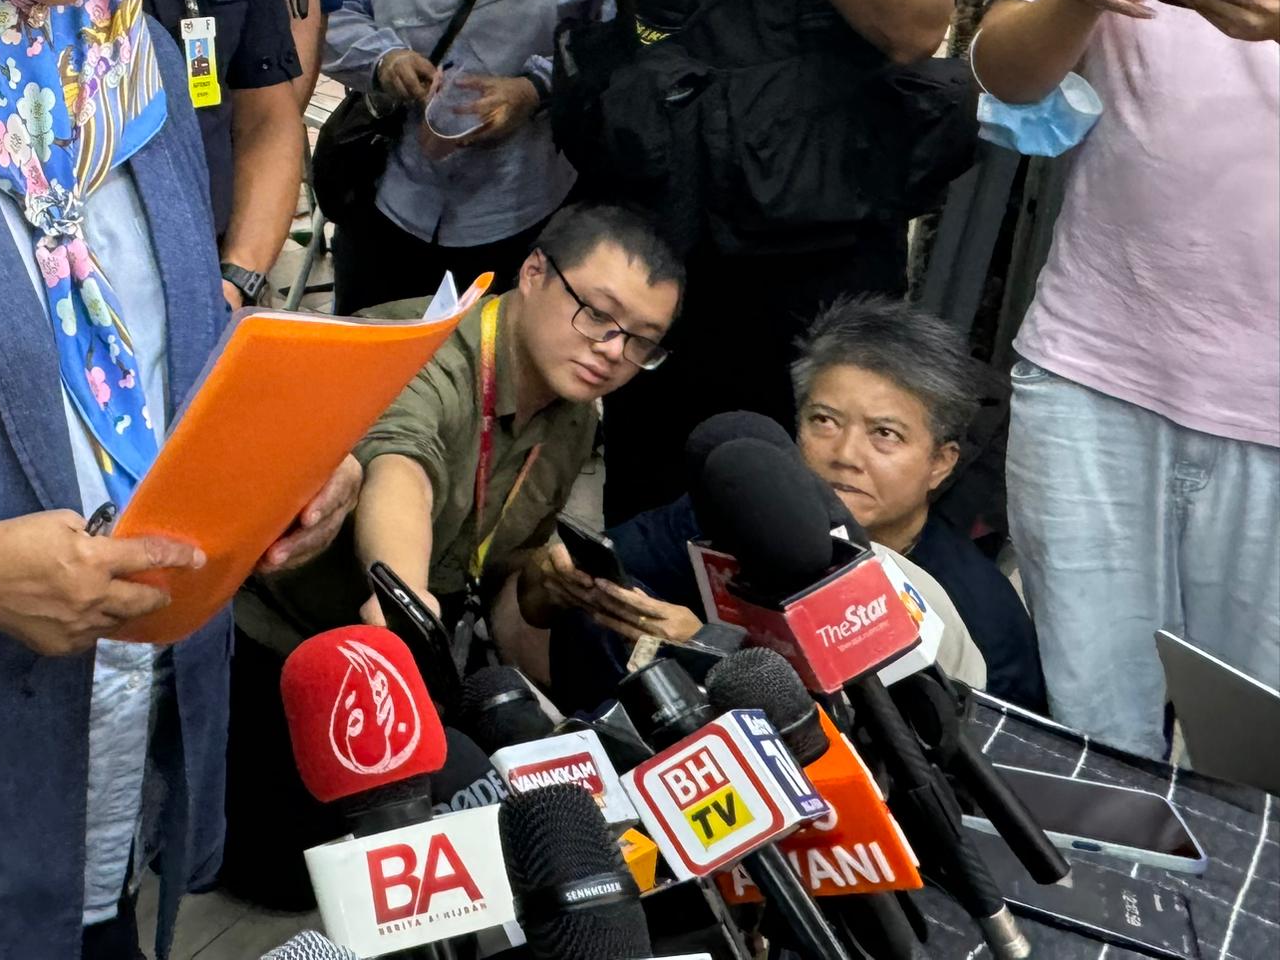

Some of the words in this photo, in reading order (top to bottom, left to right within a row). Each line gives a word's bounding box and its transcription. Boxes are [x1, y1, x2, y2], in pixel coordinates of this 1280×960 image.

[510, 760, 597, 793] VANAKKAM
[663, 750, 724, 805] BH
[691, 792, 737, 840] TV
[366, 832, 484, 925] BA
[565, 881, 622, 902] SENNHEISER
